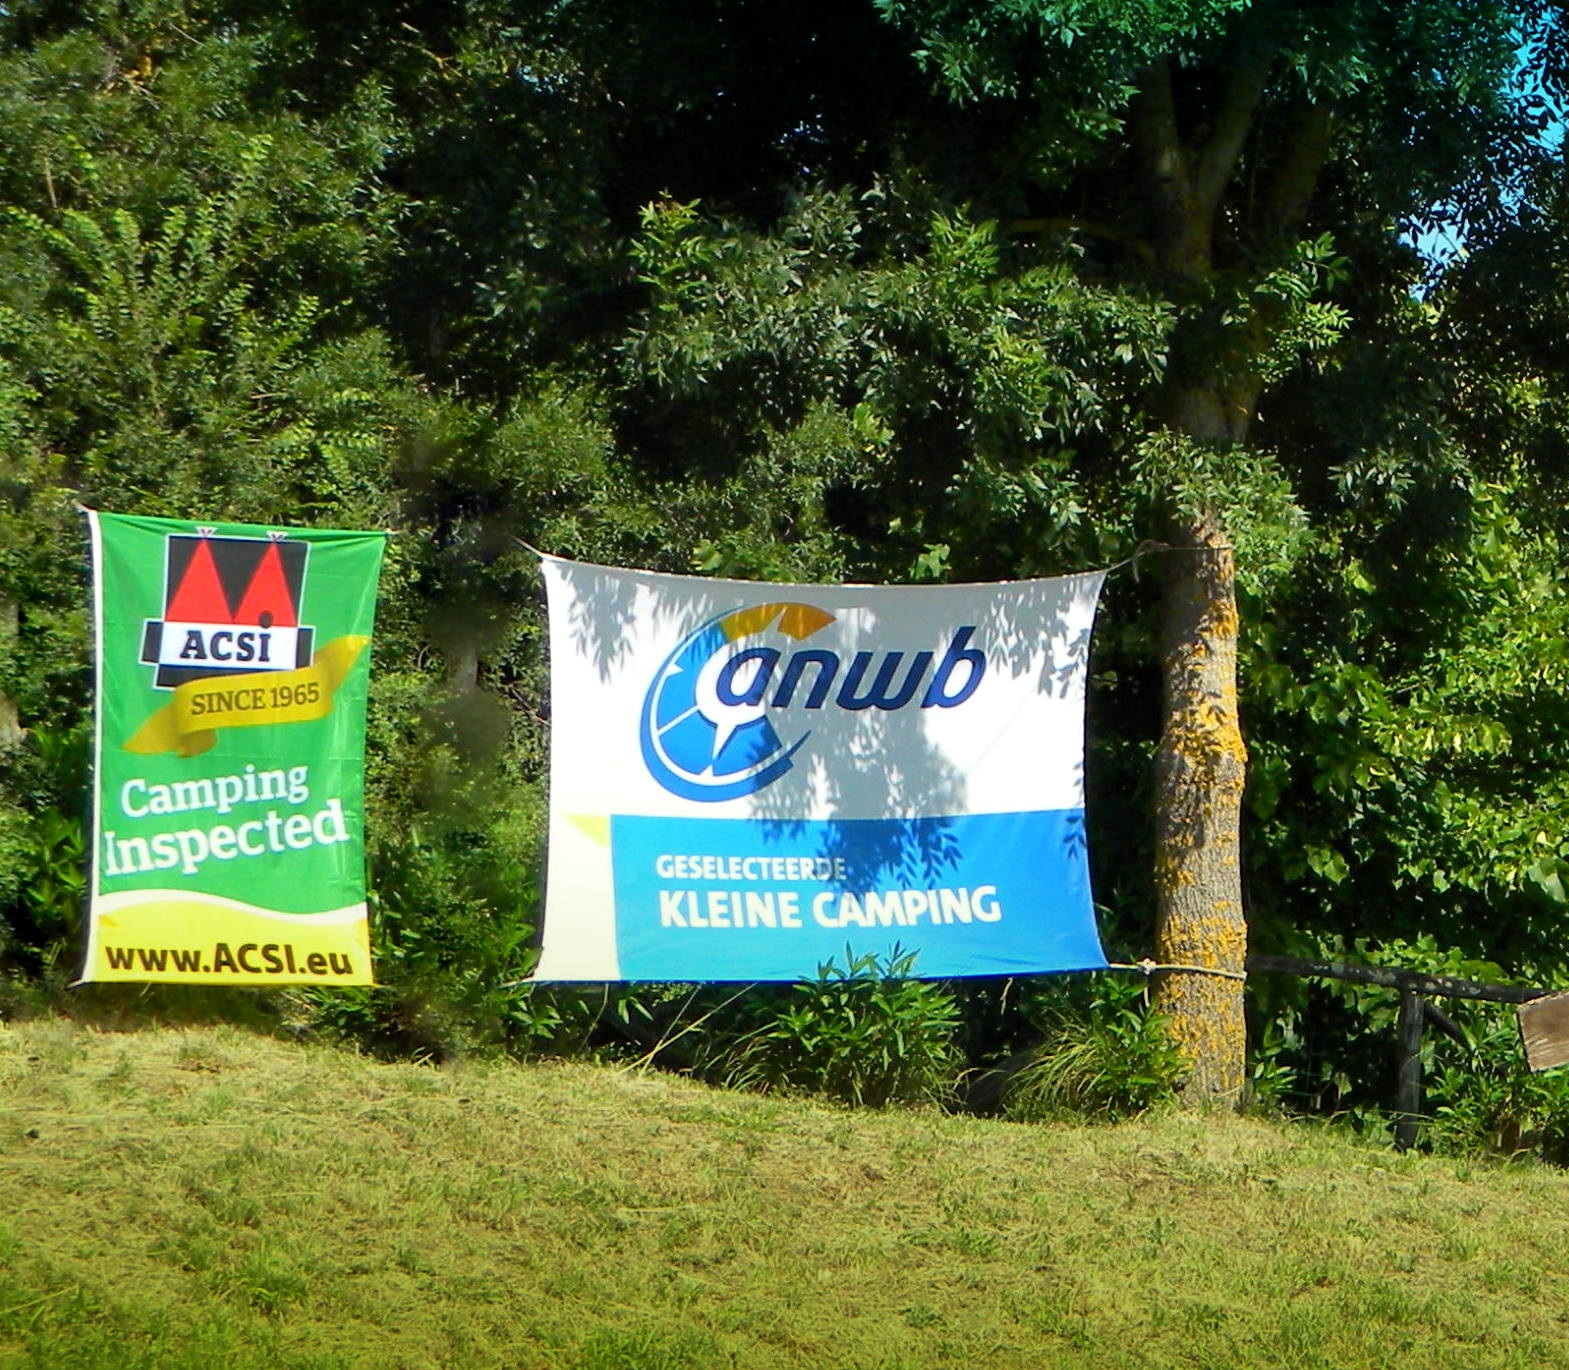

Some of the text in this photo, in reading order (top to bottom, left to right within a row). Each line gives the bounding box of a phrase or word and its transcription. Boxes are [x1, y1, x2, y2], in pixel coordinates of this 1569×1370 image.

[715, 626, 986, 711] anwb
[191, 682, 320, 715] SINCE 1965
[121, 764, 309, 819] Camping
[104, 799, 349, 876] Inspected
[656, 855, 847, 881] GESELECTEERDE
[658, 885, 1002, 928] KLEINE CAMPING
[105, 943, 353, 976] www.ACSI.eu
